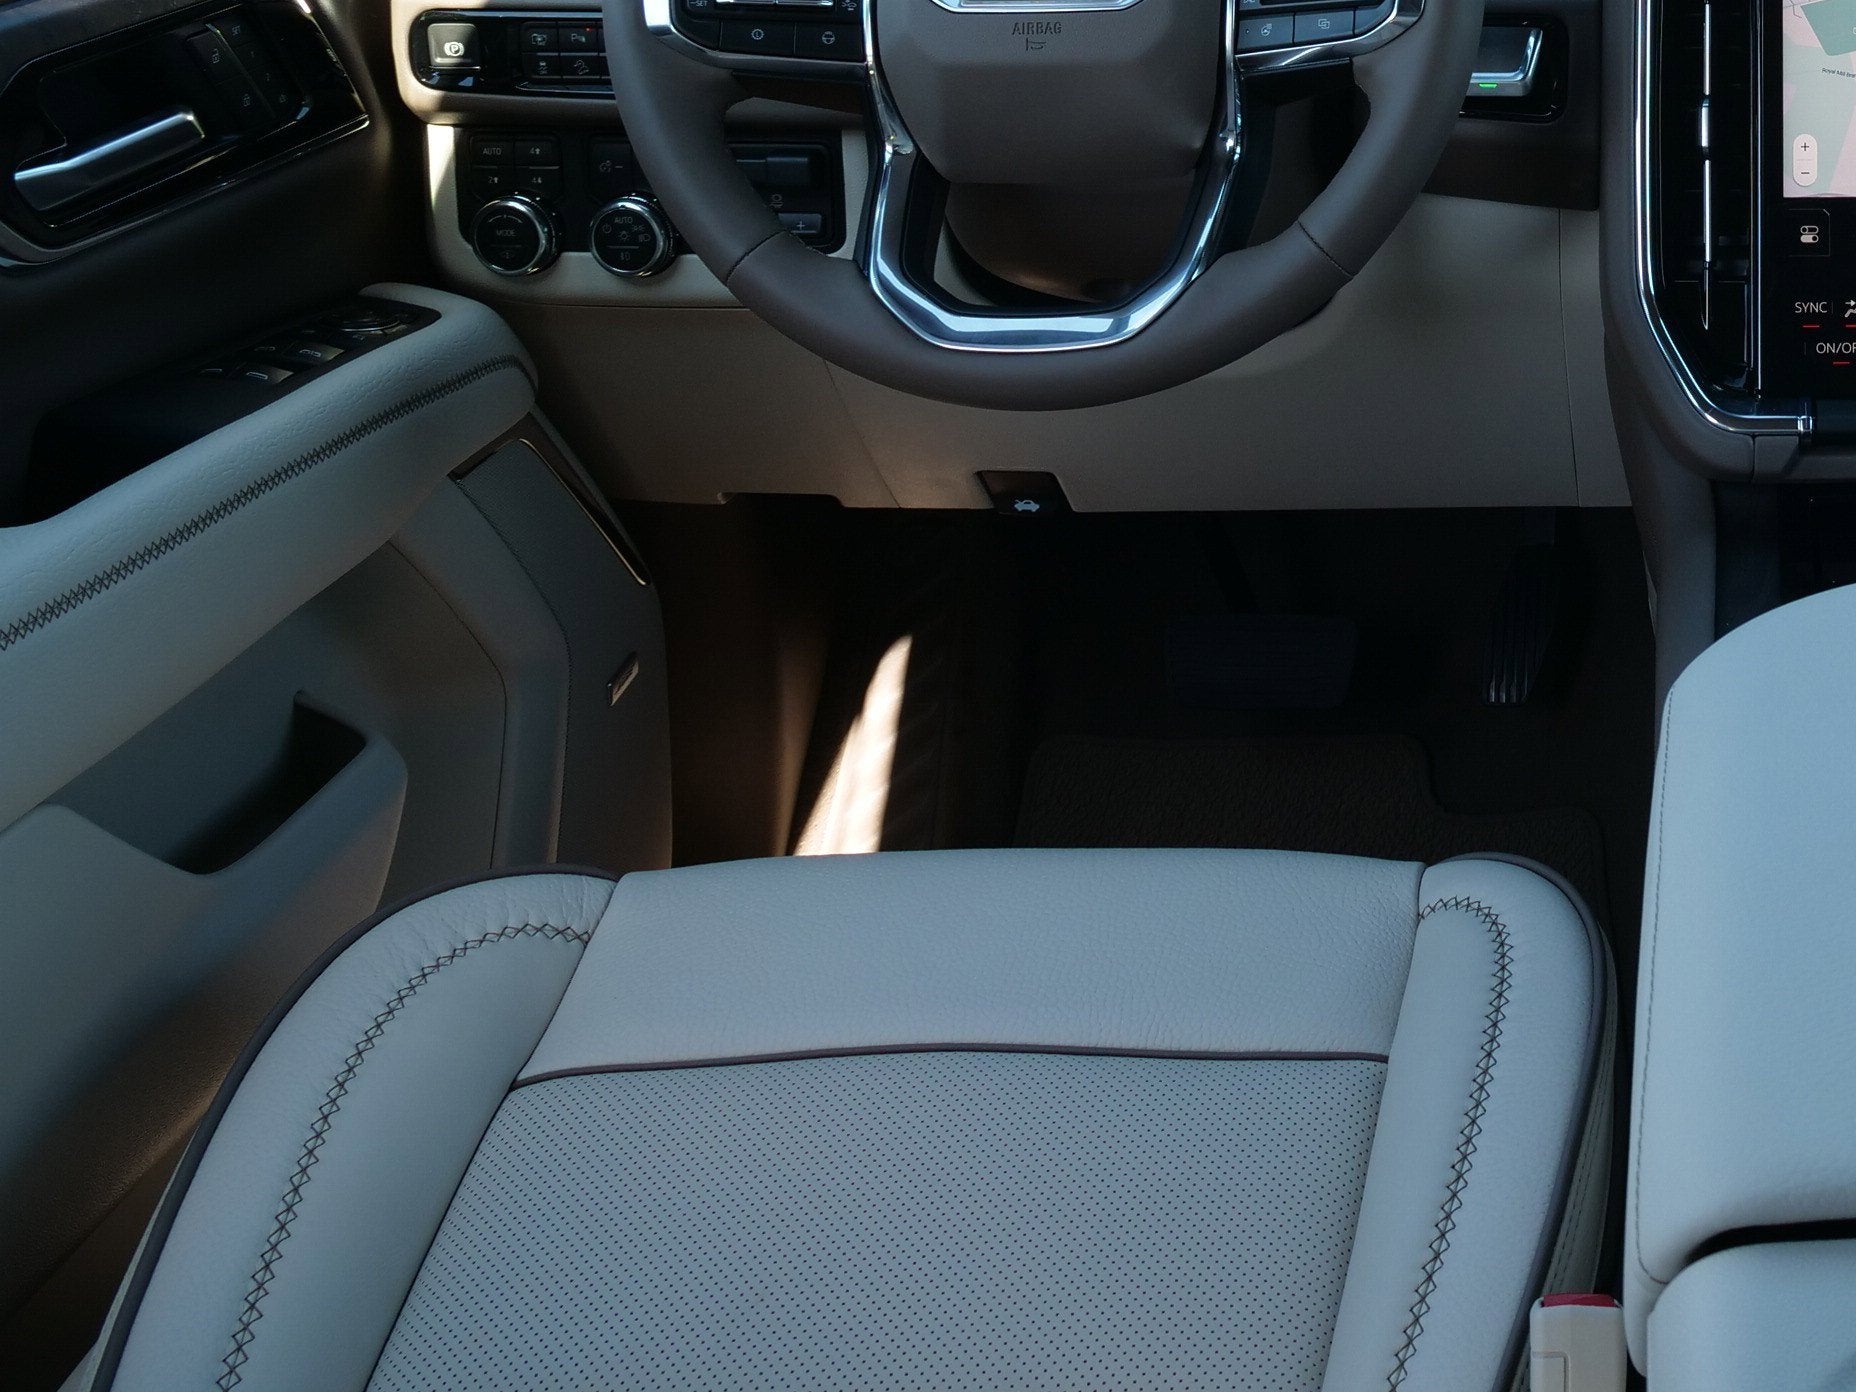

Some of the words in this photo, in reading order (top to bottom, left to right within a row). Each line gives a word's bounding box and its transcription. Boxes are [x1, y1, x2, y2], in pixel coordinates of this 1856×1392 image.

[1011, 21, 1062, 35] AIRBAG
[1821, 67, 1837, 75] Royal
[482, 147, 502, 156] AUTO
[614, 216, 633, 224] AUTO
[496, 229, 516, 237] MODE
[1794, 301, 1828, 314] SYNC
